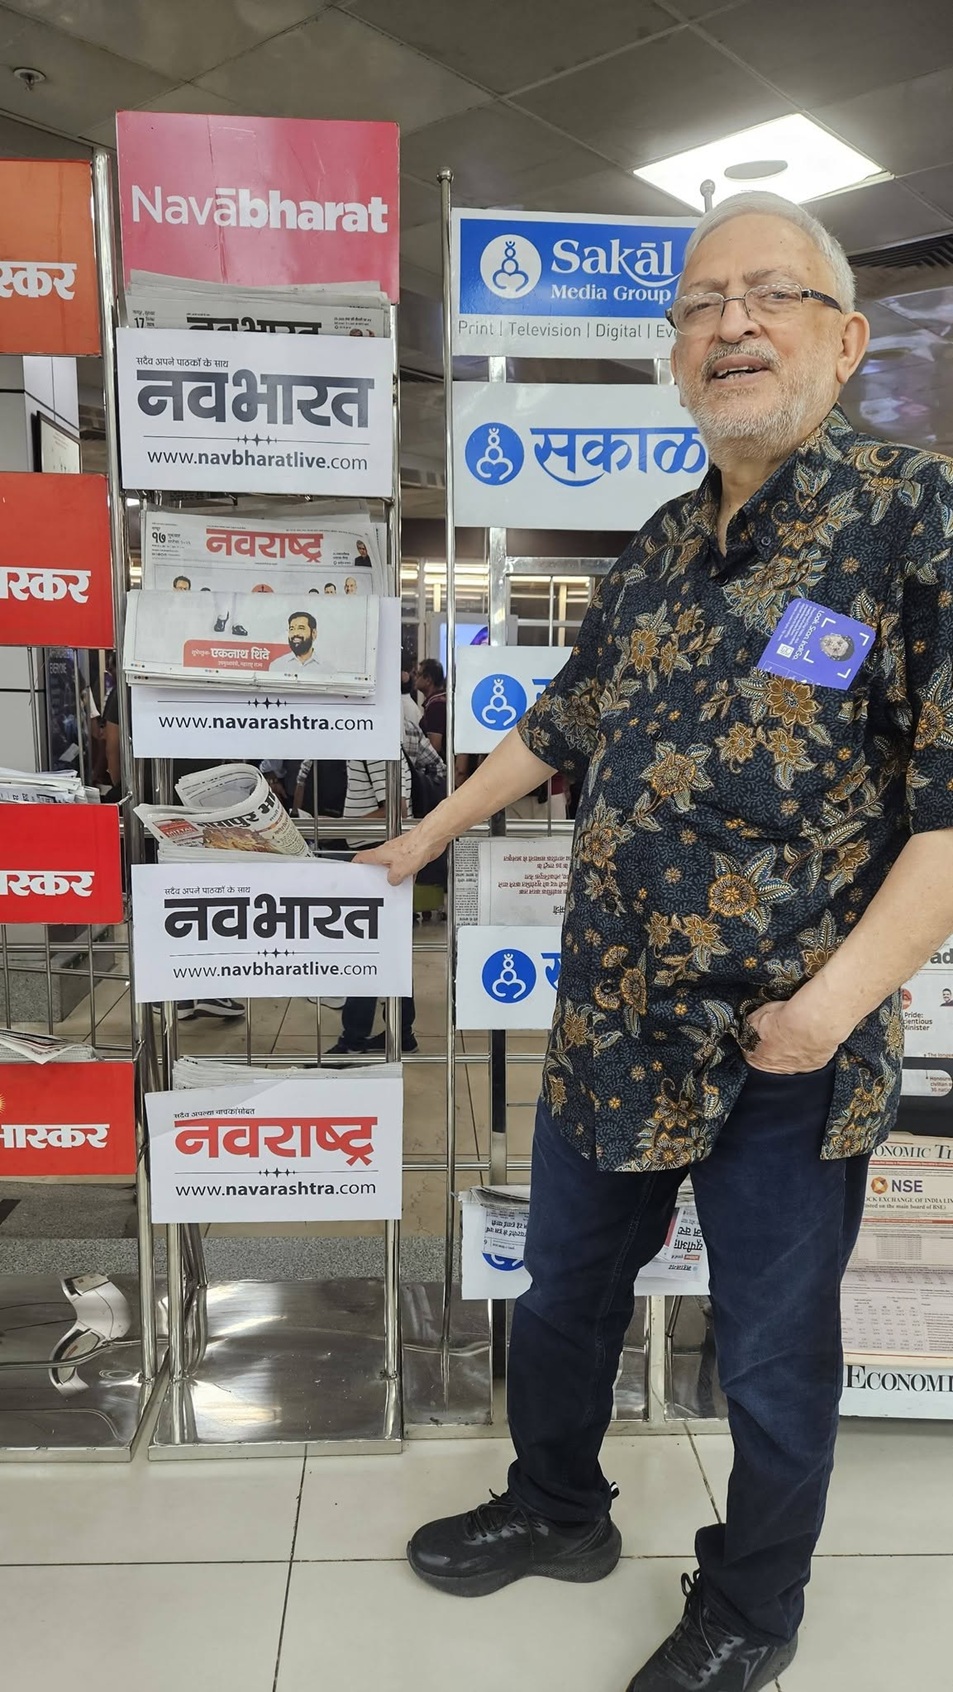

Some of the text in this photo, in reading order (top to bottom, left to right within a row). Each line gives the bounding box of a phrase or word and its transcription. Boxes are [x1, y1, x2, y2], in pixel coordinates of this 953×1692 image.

[551, 238, 682, 287] Sakāl
[0, 261, 77, 300] स्कर
[551, 284, 671, 304] Media Group
[458, 320, 494, 335] Print
[508, 321, 581, 338] Television
[596, 324, 642, 341] Digital
[136, 356, 228, 368] सदैव अपने पाठकों के साथ
[136, 369, 375, 428] नवभारत
[147, 449, 368, 471] www.navbharatlive.com
[530, 427, 707, 487] सकाळ
[206, 528, 324, 563] नवराष्ट्र
[0, 566, 91, 603] ास्कर
[210, 648, 249, 659] एकनाथ
[251, 646, 270, 660] शिंदे
[158, 714, 374, 731] www.navarashtra.com
[0, 870, 95, 897] ास्कर
[164, 886, 180, 895] सदैव
[182, 886, 200, 895] अपने
[202, 885, 225, 894] पाठकों
[227, 886, 235, 894] के
[164, 894, 384, 940] नवभारत
[173, 961, 378, 978] www.navbharatlive.com
[174, 1117, 378, 1166] नवराष्ट्र
[874, 1145, 931, 1158] ONOMIC
[176, 1181, 376, 1196] www.navarashtra.com
[892, 1180, 923, 1192] NSE
[844, 1364, 953, 1392] ECONOMI
